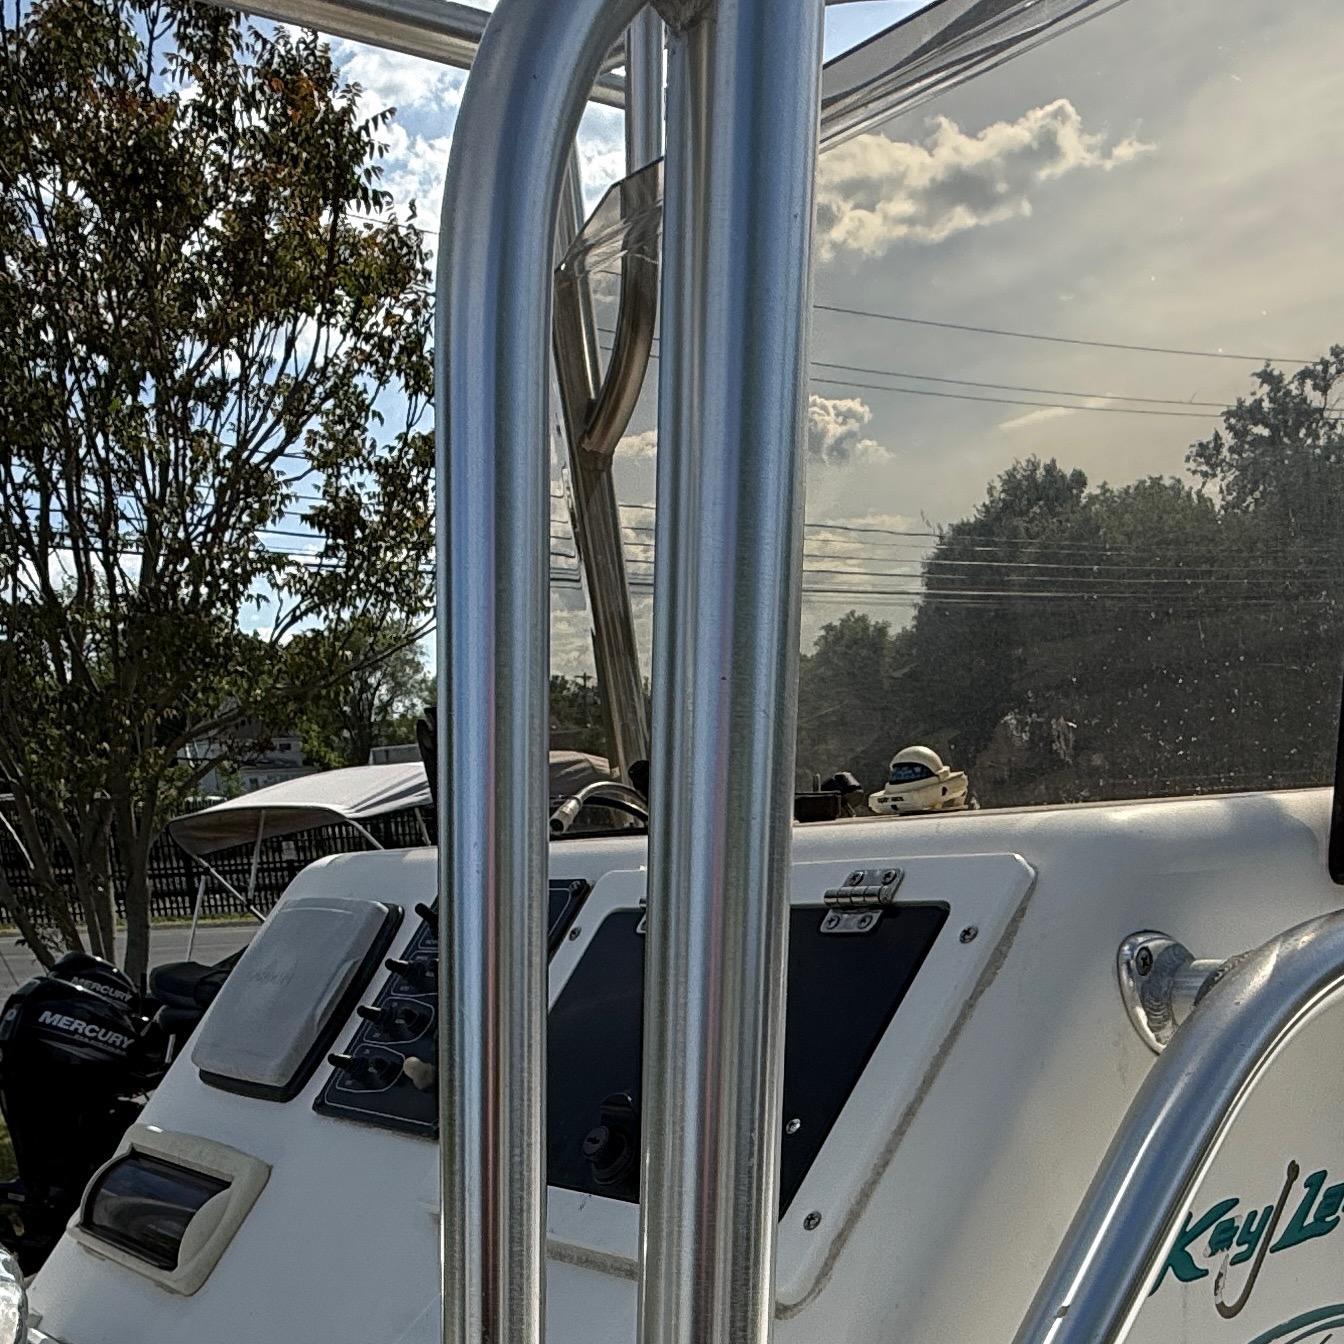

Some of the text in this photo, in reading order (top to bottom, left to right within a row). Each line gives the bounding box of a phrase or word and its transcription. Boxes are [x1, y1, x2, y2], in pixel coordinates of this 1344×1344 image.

[71, 976, 133, 1002] MERCURY
[38, 1011, 135, 1049] MERCURY
[1147, 1197, 1274, 1298] Key
